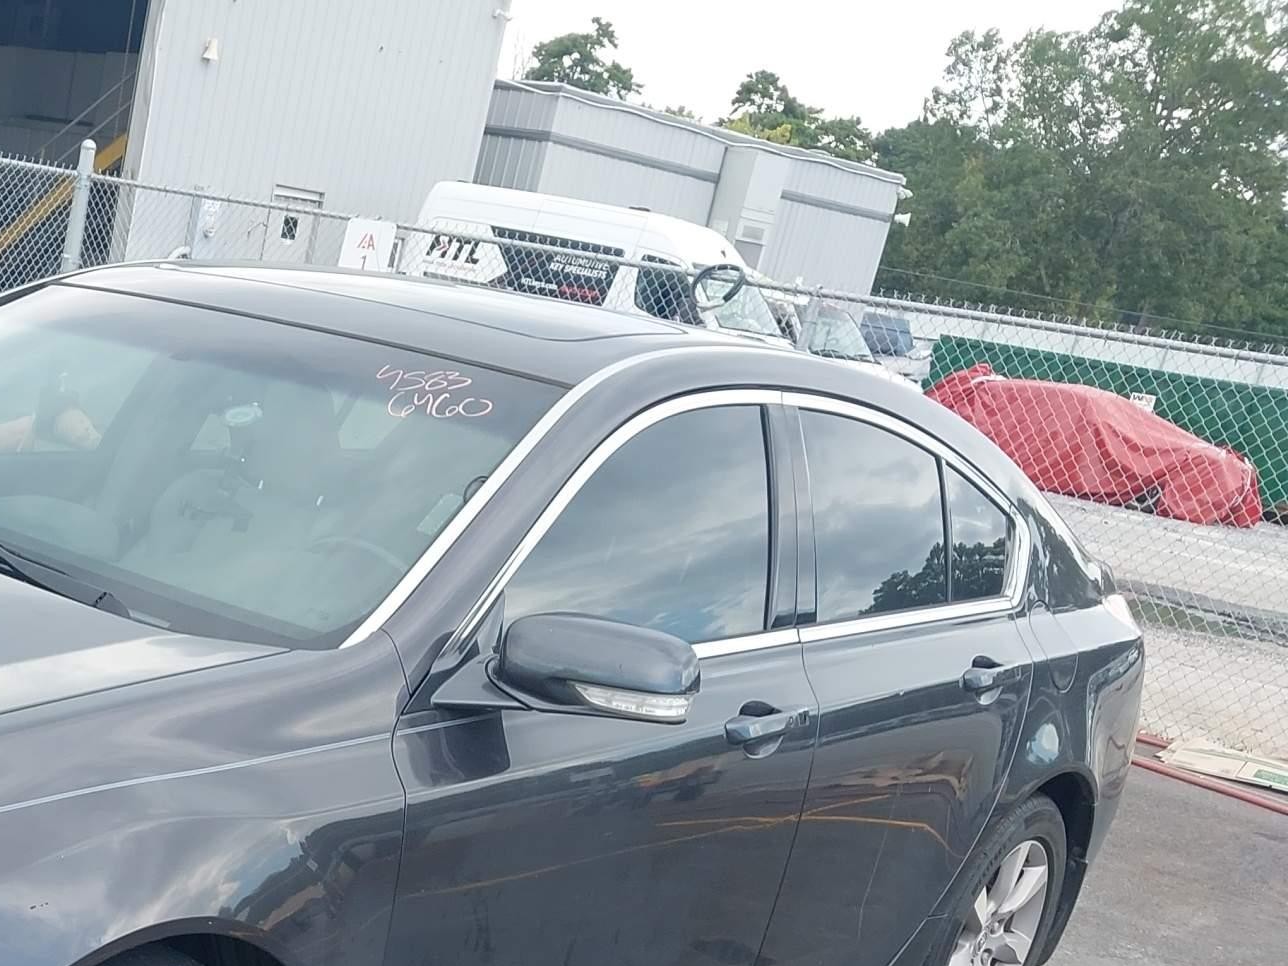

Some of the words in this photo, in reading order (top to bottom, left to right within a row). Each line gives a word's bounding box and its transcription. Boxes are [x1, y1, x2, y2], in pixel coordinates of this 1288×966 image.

[563, 265, 607, 279] SPECIALISTS
[376, 365, 472, 391] 4583
[388, 391, 493, 418] 6460
